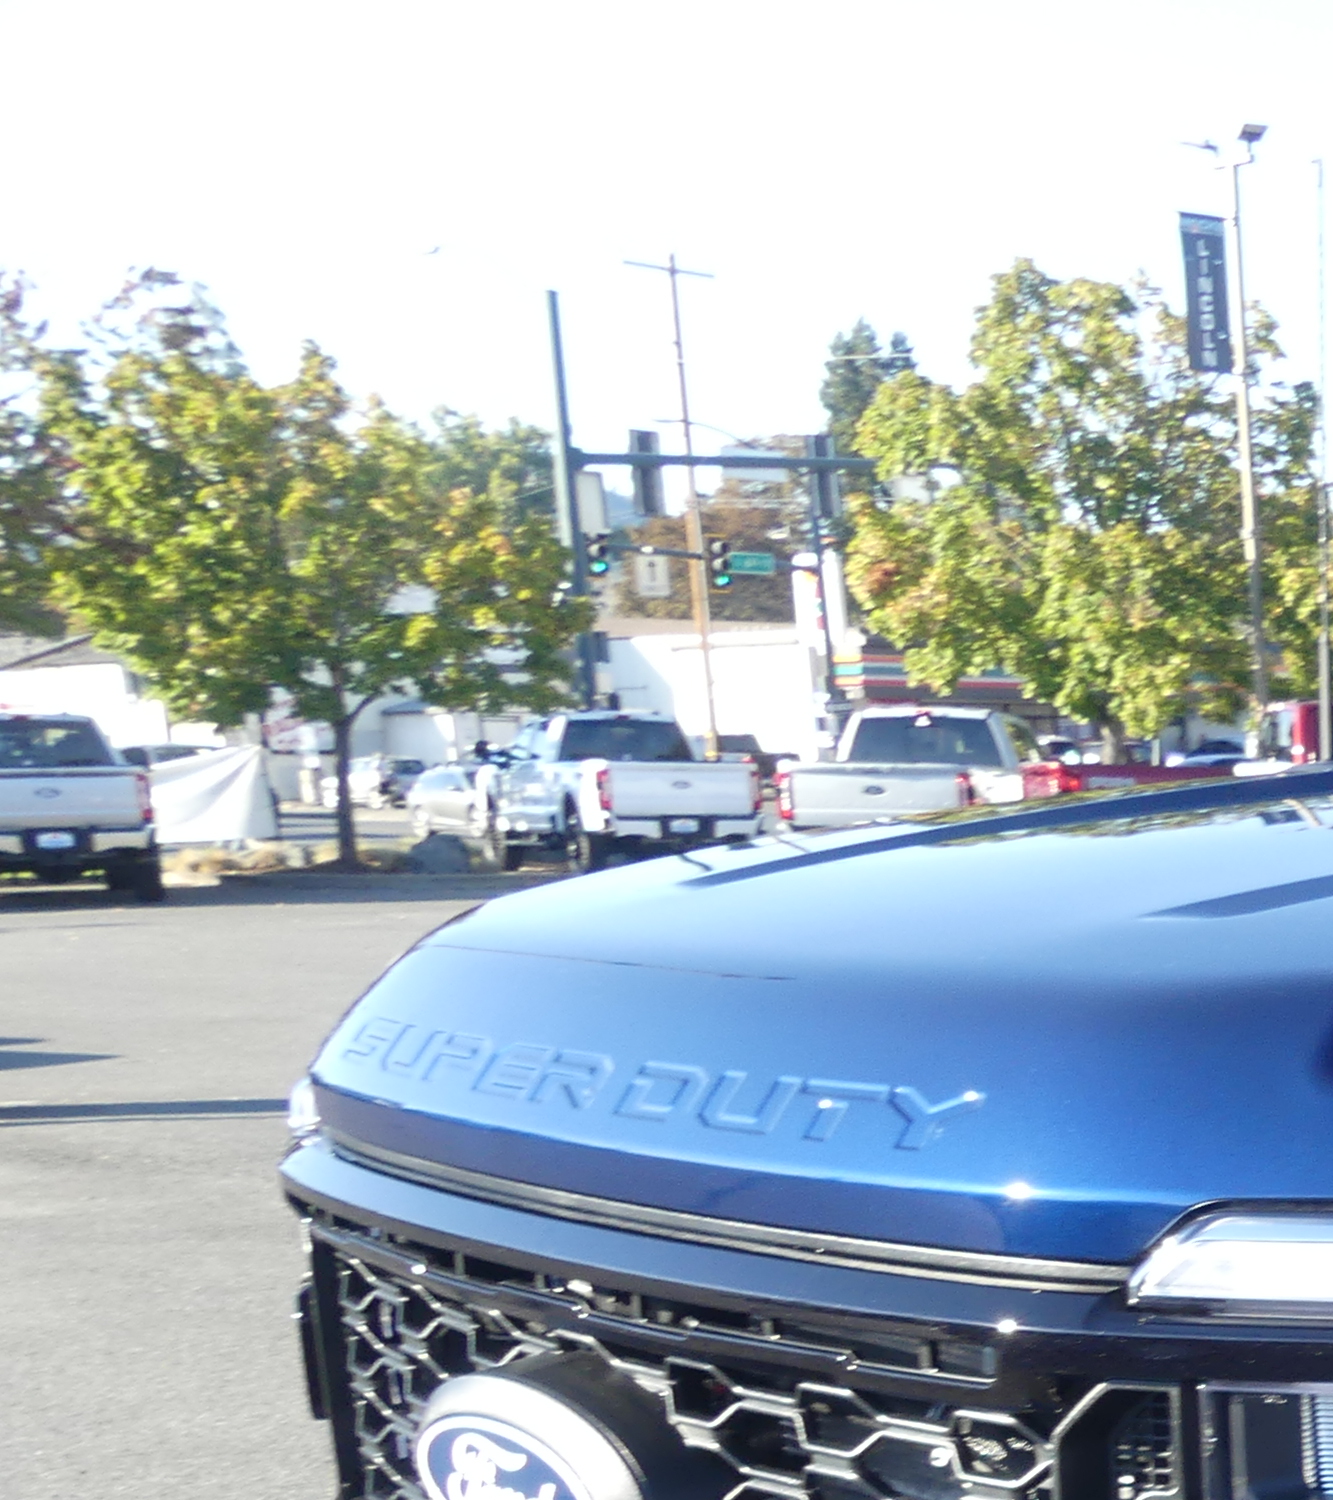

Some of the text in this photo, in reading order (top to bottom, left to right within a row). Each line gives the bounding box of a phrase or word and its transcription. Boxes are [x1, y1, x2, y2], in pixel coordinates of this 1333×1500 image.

[1196, 239, 1218, 367] LINCOLN
[344, 1016, 988, 1152] SUPER DUTY
